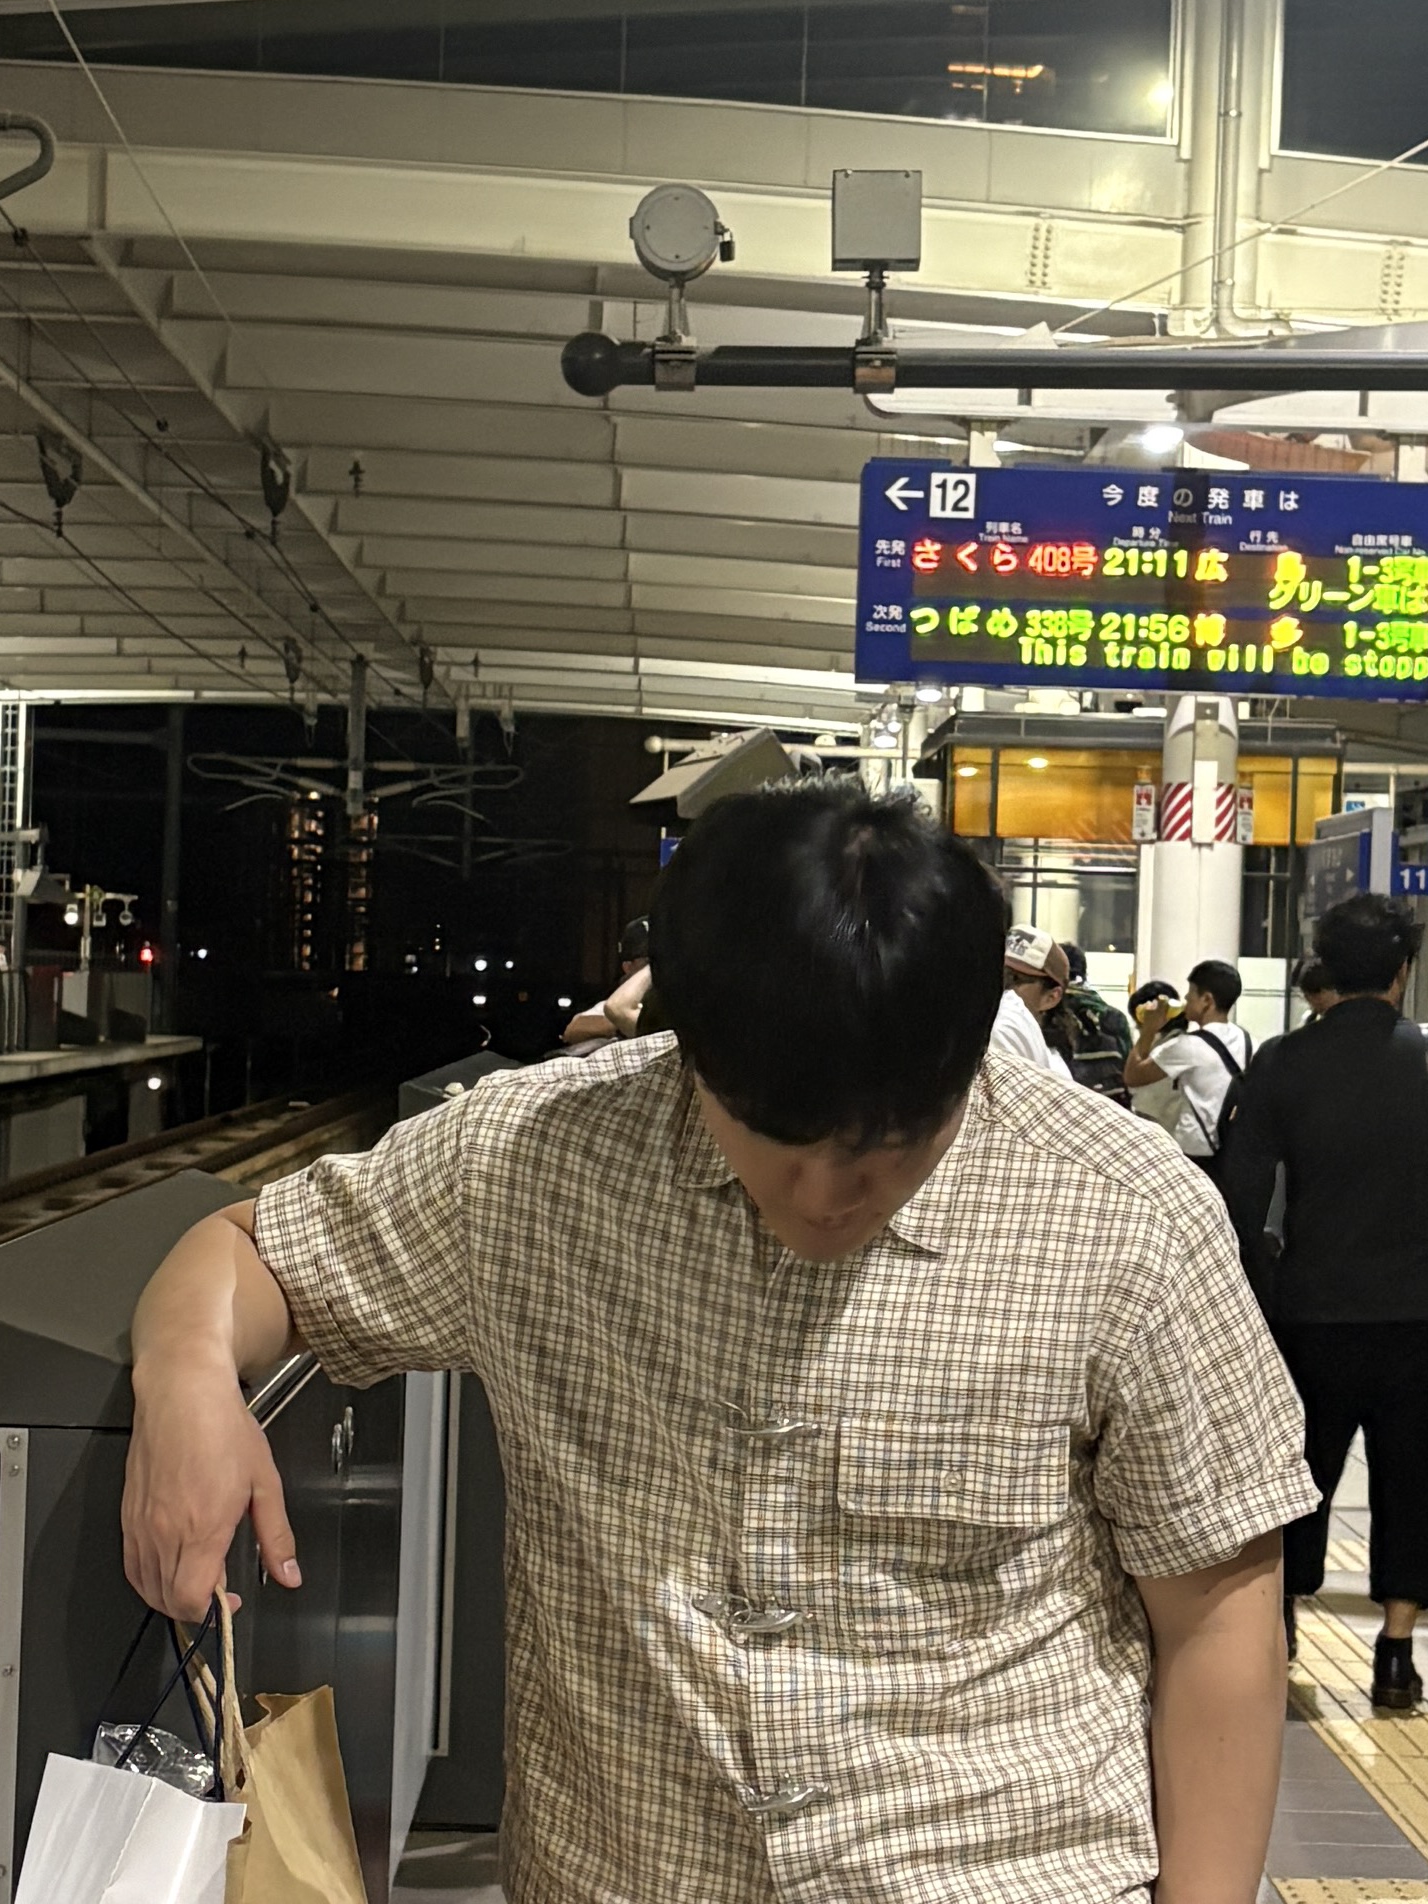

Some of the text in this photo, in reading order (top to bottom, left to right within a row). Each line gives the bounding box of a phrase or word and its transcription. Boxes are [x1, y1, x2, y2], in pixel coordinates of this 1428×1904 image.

[935, 478, 971, 512] 12
[1202, 511, 1232, 526] Train
[1102, 547, 1188, 578] 21:11
[1099, 612, 1190, 644] 21:56
[1018, 637, 1088, 667] This
[1104, 641, 1191, 670] train
[1400, 868, 1426, 890] 11
